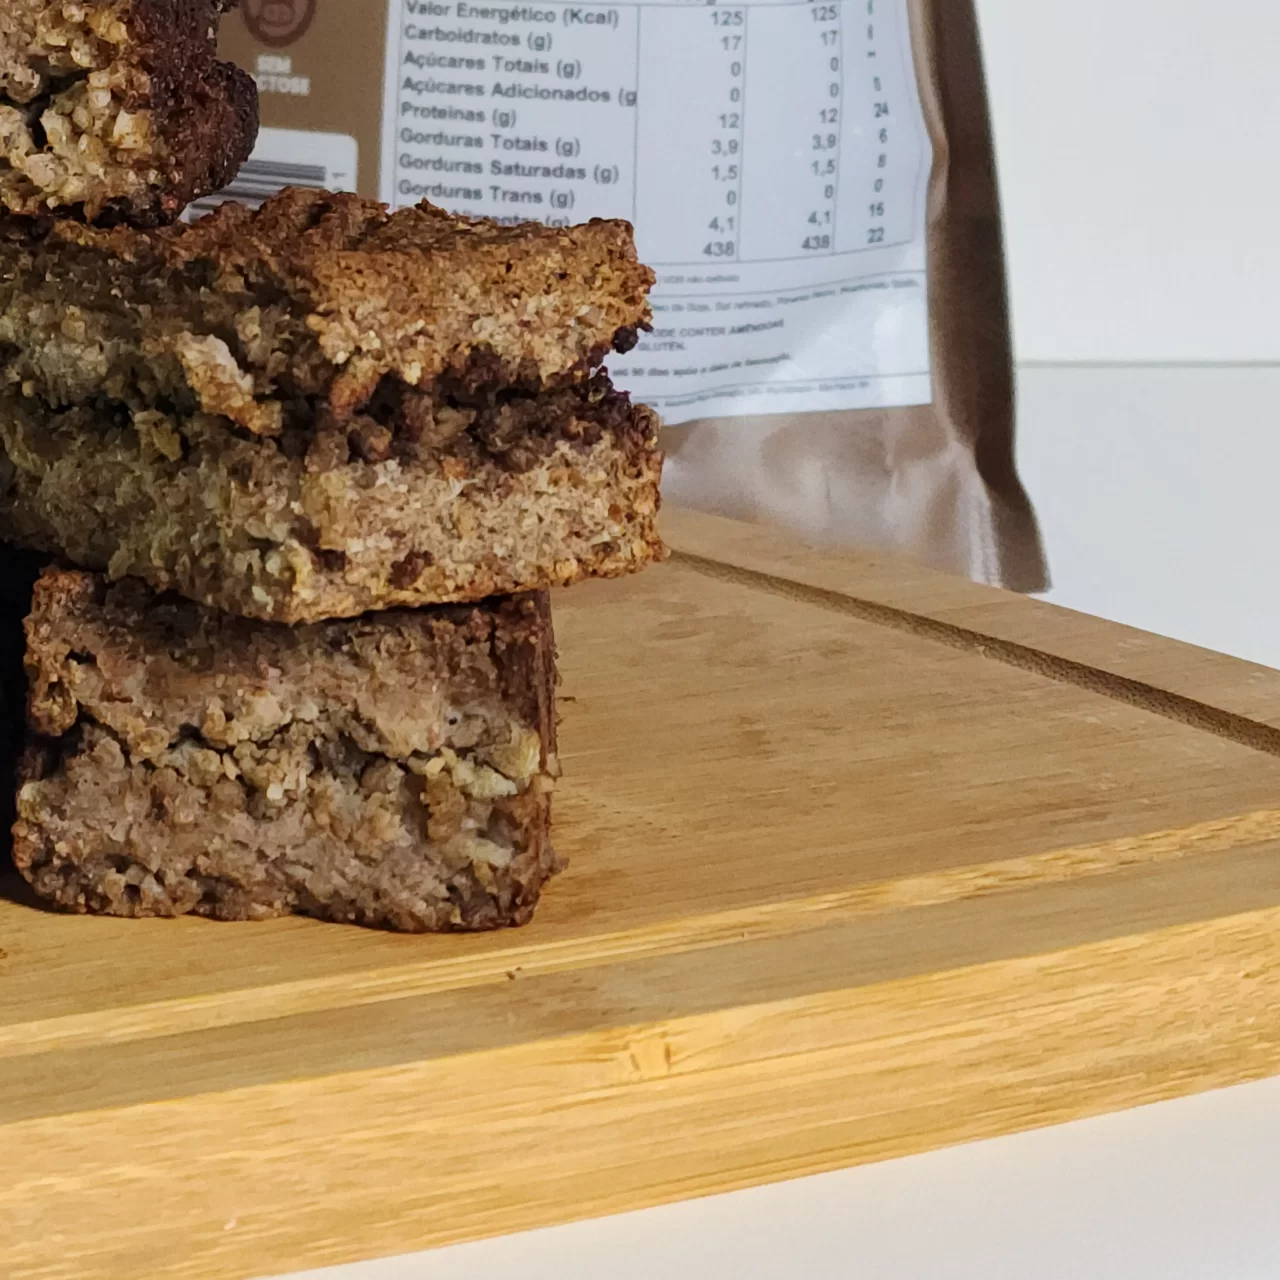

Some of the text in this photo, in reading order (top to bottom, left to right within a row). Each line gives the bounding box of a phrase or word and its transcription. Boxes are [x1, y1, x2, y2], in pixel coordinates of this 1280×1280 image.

[405, 0, 620, 30] Valor Energético (Kcal)
[710, 10, 744, 26] 125
[811, 5, 838, 22] 125
[404, 23, 553, 51] Carboidratos (g)
[721, 35, 743, 51] 17
[820, 30, 838, 46] 17
[403, 50, 582, 79] Açúcares Totais (g)
[730, 61, 741, 77] 0
[830, 57, 840, 72] 0
[402, 76, 485, 97] Açúcares
[491, 81, 611, 102] Adicionados
[730, 87, 741, 103] 0
[829, 82, 839, 98] 0
[491, 107, 517, 128] (g)
[719, 112, 740, 129] 12
[819, 108, 838, 124] 12
[399, 127, 581, 157] Gorduras Totais (g)
[710, 138, 739, 158] 3,9
[811, 133, 837, 151] 3,9
[398, 153, 619, 185] Gorduras Saturadas (g)
[711, 164, 738, 182] 1,5
[811, 159, 836, 177] 1,5
[397, 178, 576, 209] Gorduras Trans (g)
[726, 190, 737, 206] 0
[824, 184, 834, 199] 0
[708, 217, 735, 233] 4,1
[807, 210, 831, 227] 4,1
[702, 240, 735, 257] 438
[801, 234, 831, 251] 438
